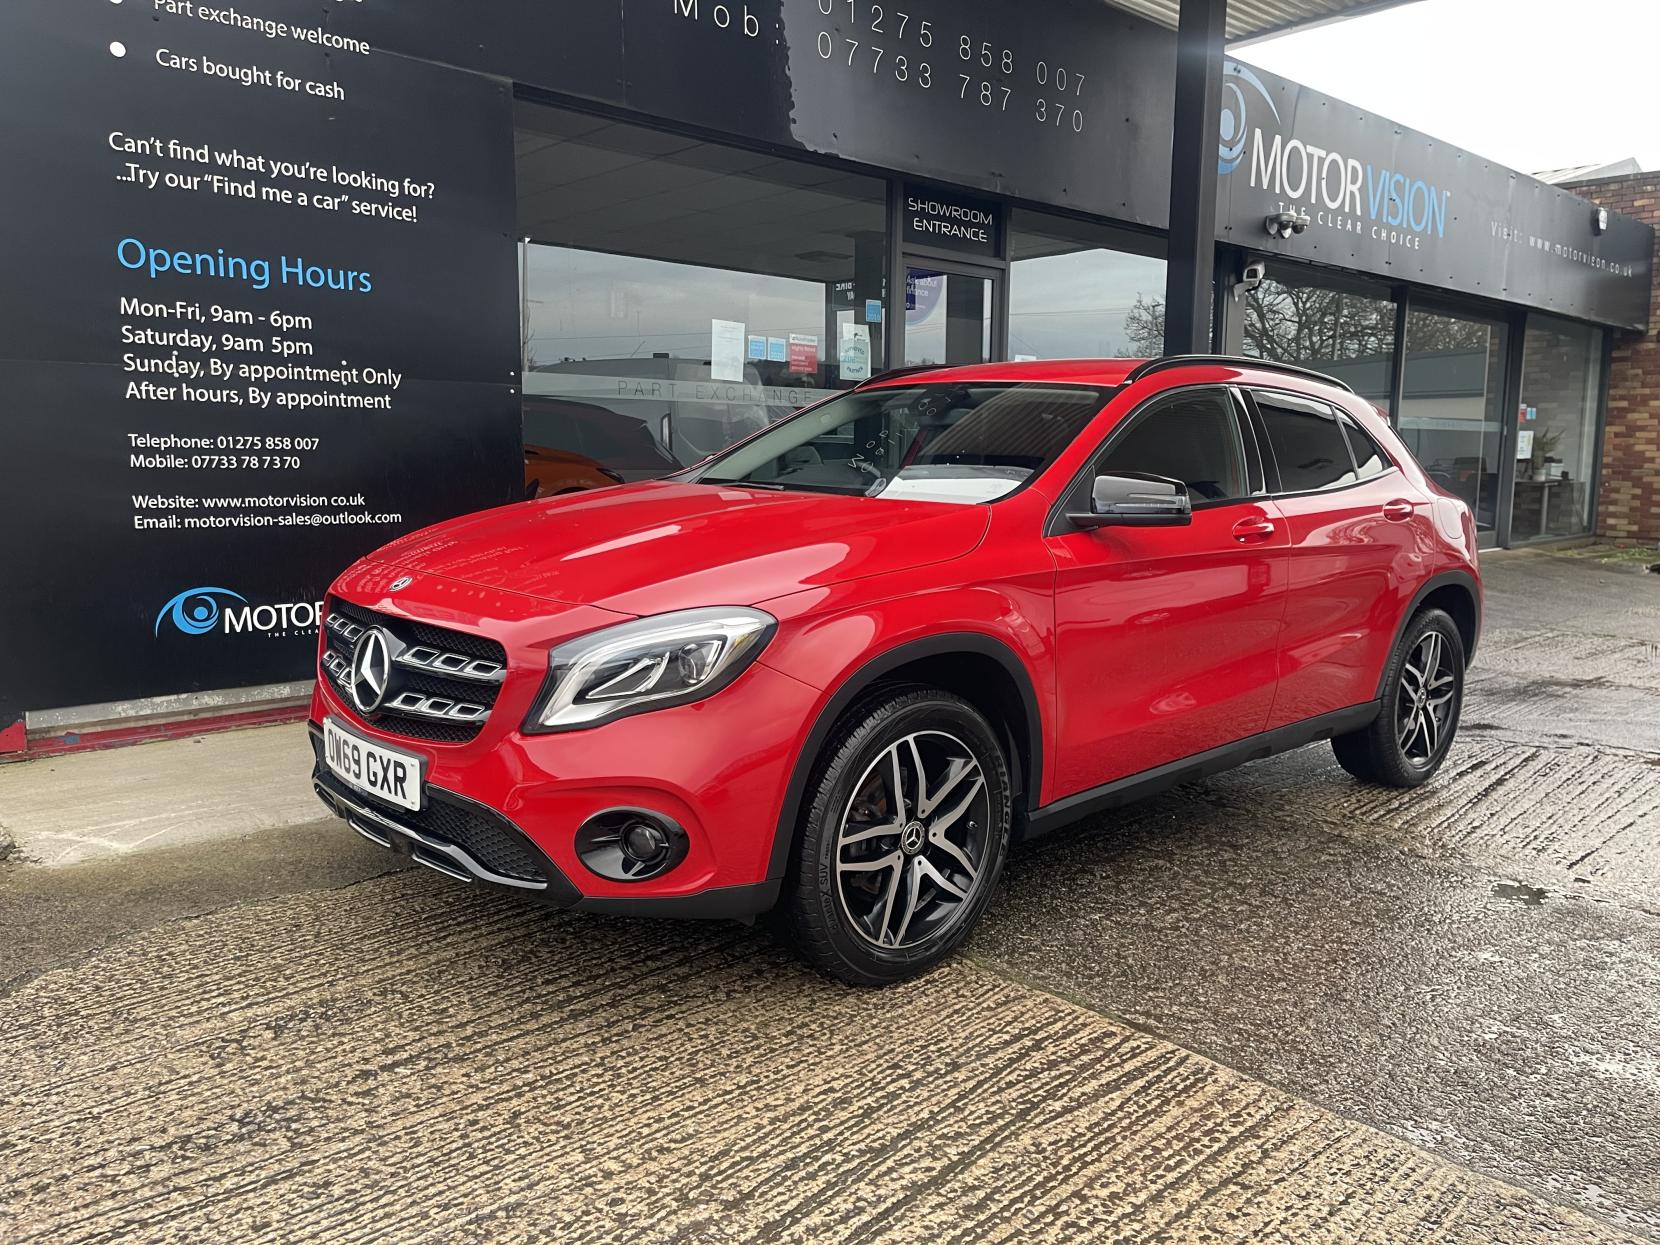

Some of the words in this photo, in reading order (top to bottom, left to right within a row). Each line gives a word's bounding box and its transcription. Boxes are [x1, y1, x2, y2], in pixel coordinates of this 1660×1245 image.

[154, 0, 193, 17] Part
[198, 6, 287, 38] exchange
[291, 27, 370, 54] welcome
[156, 48, 198, 71] Cars
[203, 56, 272, 85] bought
[276, 71, 302, 91] for
[306, 81, 345, 100] cash
[817, 32, 931, 88] 07733
[960, 74, 1011, 111] 787
[1036, 99, 1083, 132] 370
[960, 35, 1013, 74] 858
[1037, 61, 1086, 97] 007
[168, 140, 209, 163] find
[214, 149, 265, 172] what
[332, 166, 399, 197] looking
[403, 178, 435, 199] for?
[1250, 128, 1363, 216] MOTOR
[1366, 164, 1449, 238] VISION
[165, 170, 201, 190] our
[262, 186, 292, 203] me
[297, 191, 308, 206] a
[351, 198, 418, 222] service!
[908, 198, 993, 225] SHOWROOM
[913, 218, 988, 242] ENTRANCE
[1317, 212, 1362, 234] CLEAR
[1371, 227, 1420, 249] CHOICE
[117, 238, 270, 289] Opening
[281, 256, 372, 292] Hours
[119, 297, 206, 323] Mon-Fri,
[210, 305, 253, 325] 9am
[270, 310, 312, 331] 6pm
[121, 325, 217, 352] Saturday,
[221, 333, 264, 352] 9am
[271, 337, 313, 356] 5pm
[123, 353, 205, 379] Sunday,
[210, 358, 234, 381] By
[239, 363, 358, 384] appointment
[362, 368, 402, 390] Only
[125, 381, 178, 401] After
[182, 383, 243, 405] hours,
[248, 388, 271, 409] By
[276, 391, 391, 409] appointment
[617, 380, 676, 397] PART
[695, 384, 812, 403] EXCHANGE
[128, 434, 214, 451] Telephone:
[217, 436, 262, 449] 01275
[265, 437, 291, 450] 858
[294, 438, 319, 450] 007
[130, 454, 188, 469] Mobile:
[192, 456, 238, 468] 07733
[132, 495, 199, 509] Website:
[134, 514, 181, 529] Email:
[184, 511, 402, 529] motorvision-sales@outlook.com
[328, 728, 361, 780] OW69
[366, 751, 407, 799] GXR
[819, 863, 829, 885] SUV
